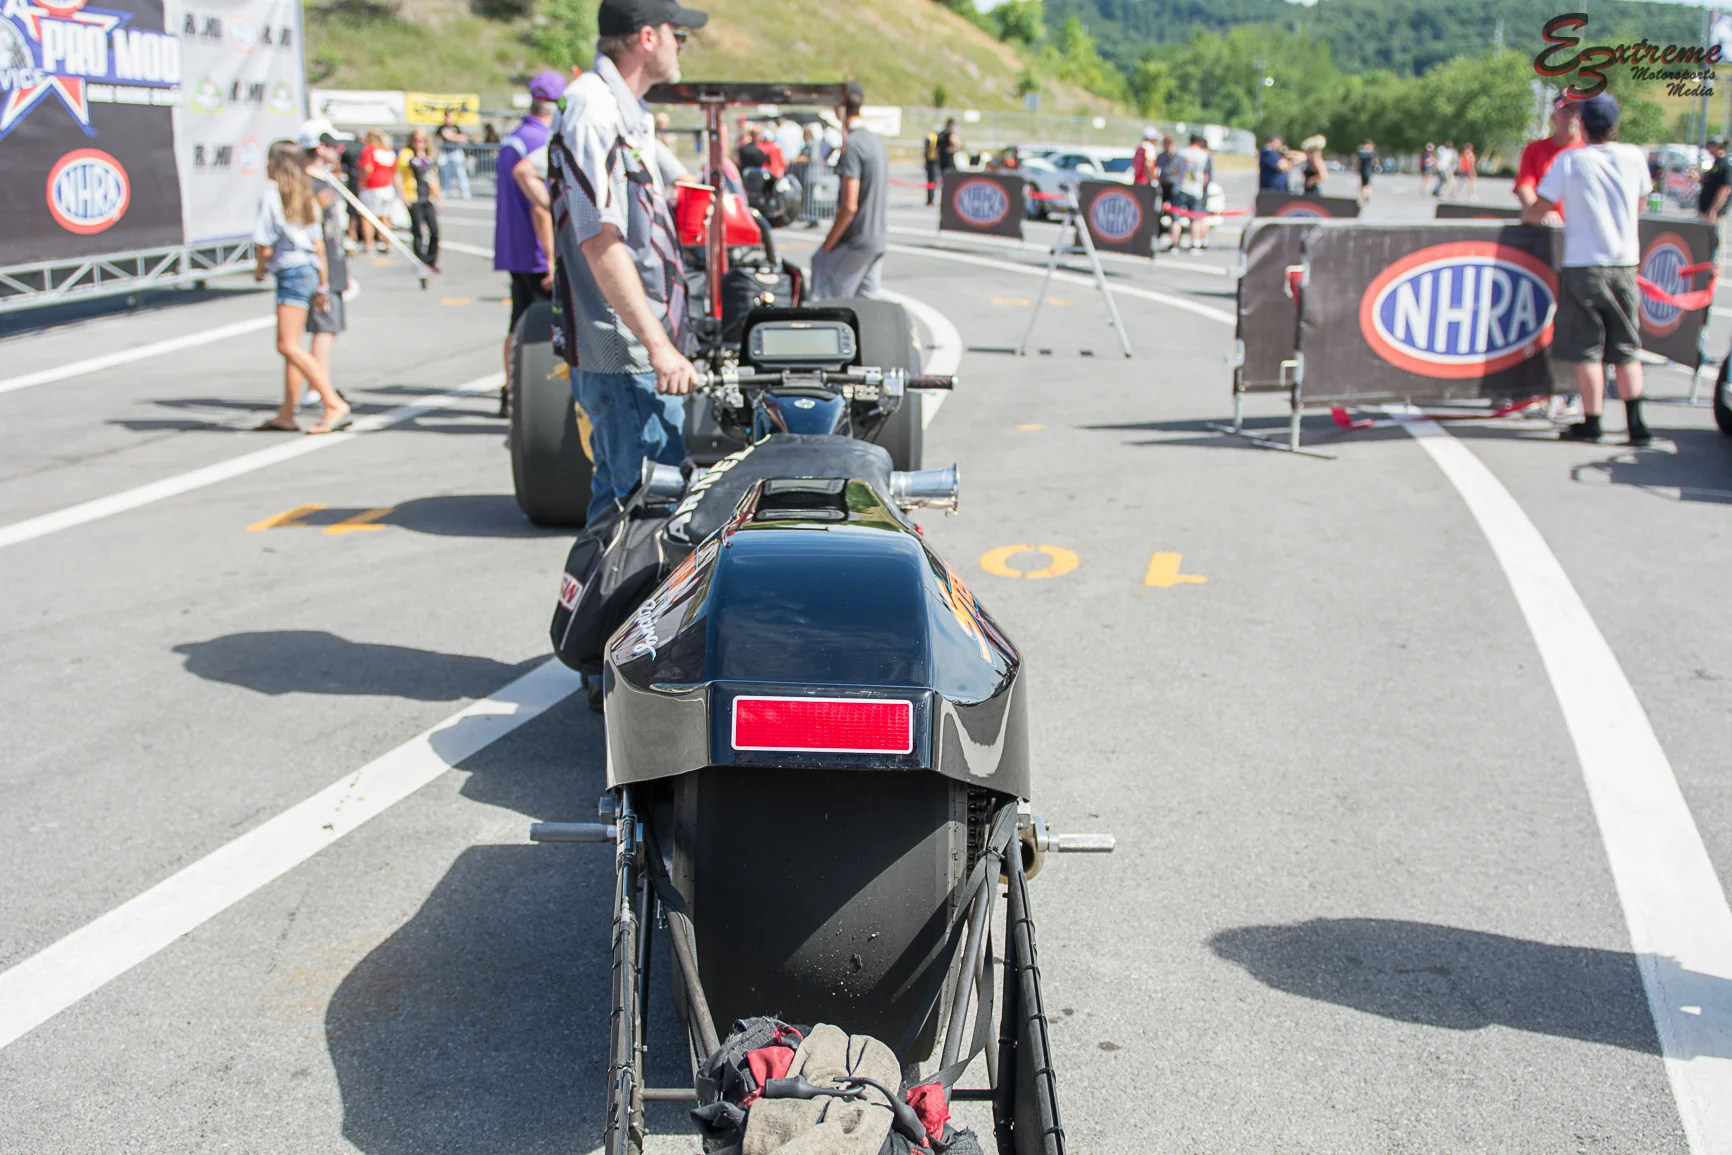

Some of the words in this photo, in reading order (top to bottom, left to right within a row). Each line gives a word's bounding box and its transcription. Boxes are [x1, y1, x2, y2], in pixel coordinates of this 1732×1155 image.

[40, 18, 108, 77] PRO
[112, 27, 182, 83] MOD
[58, 164, 121, 218] NHRA
[1393, 265, 1538, 354] NHRA
